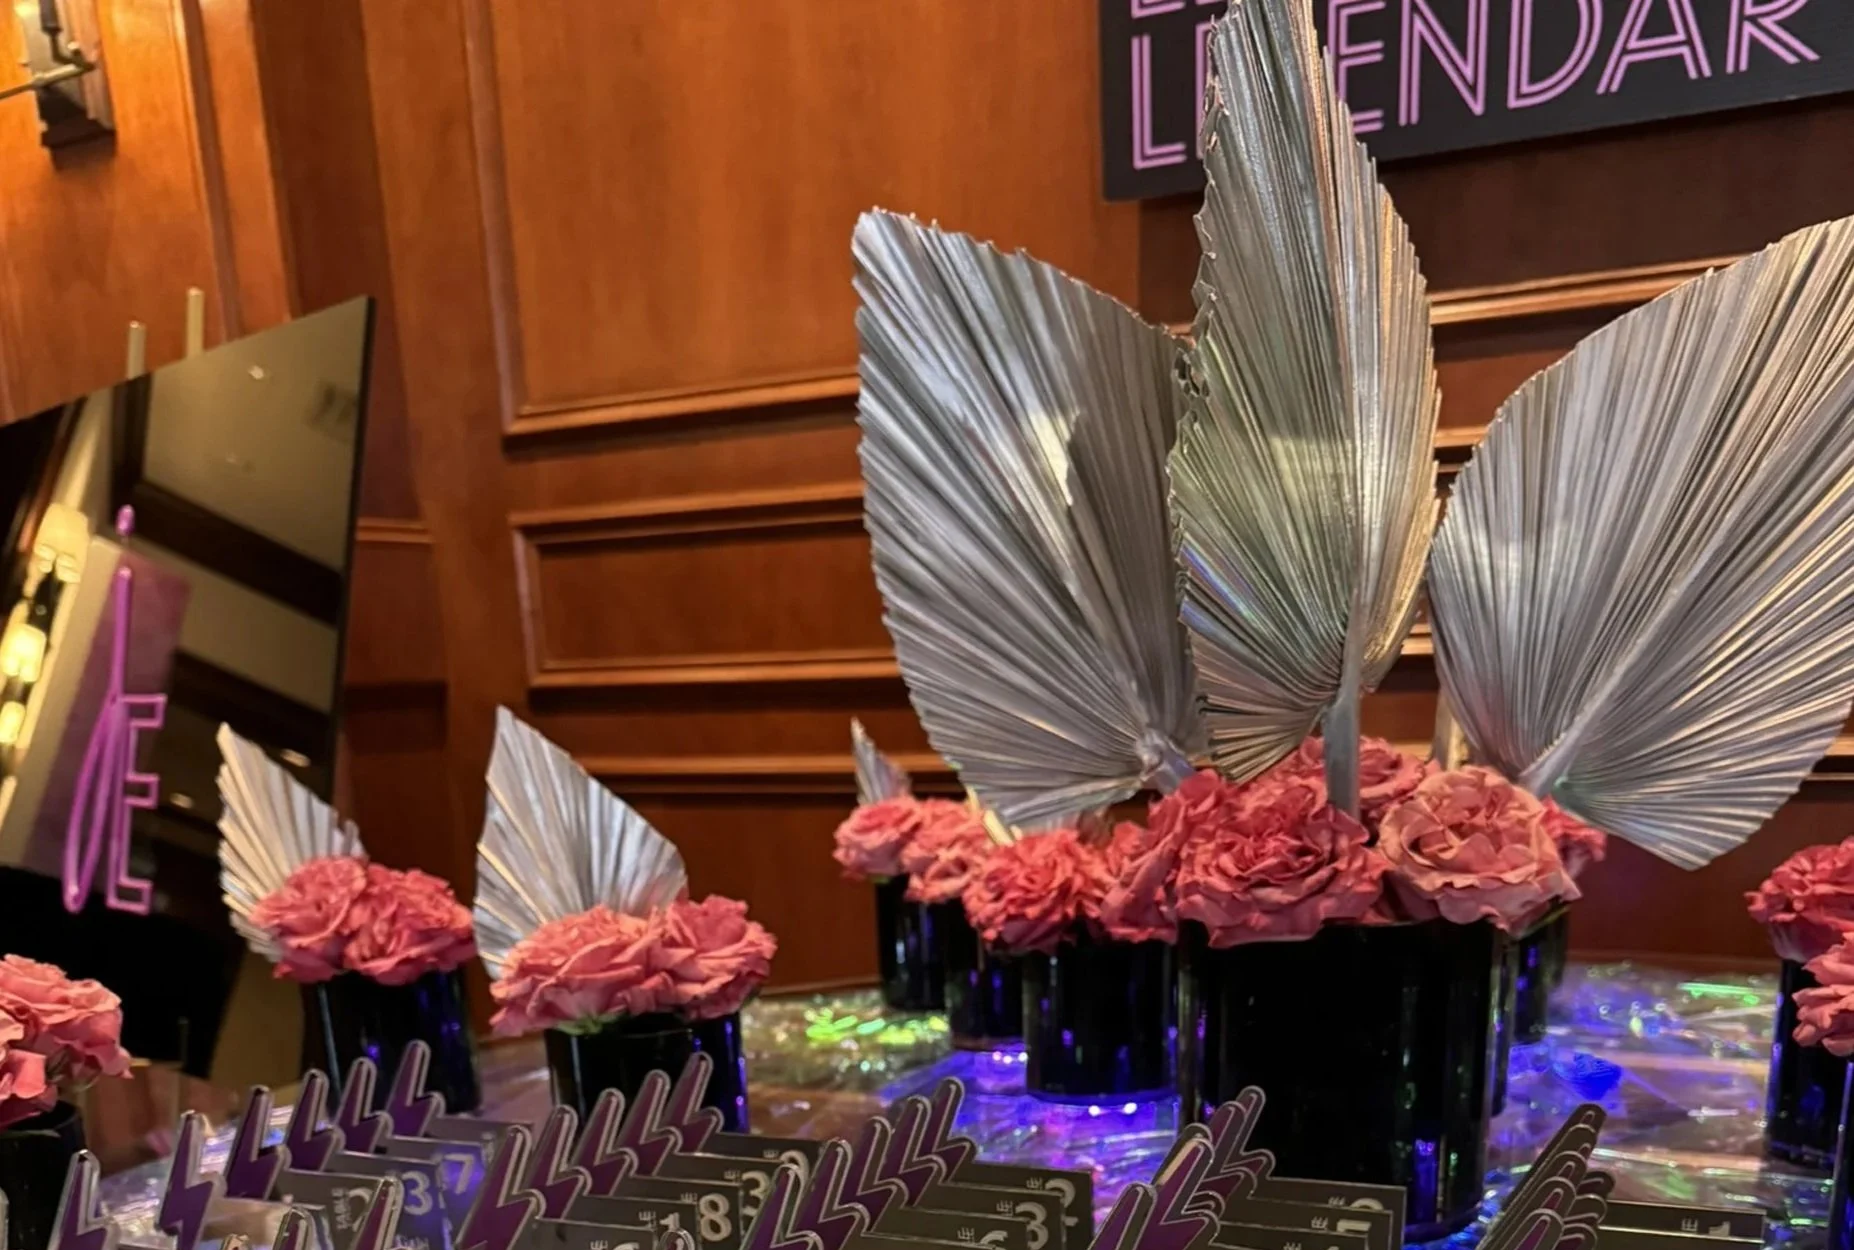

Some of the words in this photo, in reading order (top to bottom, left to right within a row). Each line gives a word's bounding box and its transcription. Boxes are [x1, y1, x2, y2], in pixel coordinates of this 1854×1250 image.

[1131, 0, 1820, 170] LENDAR
[401, 1170, 433, 1215] 3
[444, 1153, 474, 1195] 7
[699, 1193, 732, 1241] 8
[1015, 1201, 1049, 1250] 3
